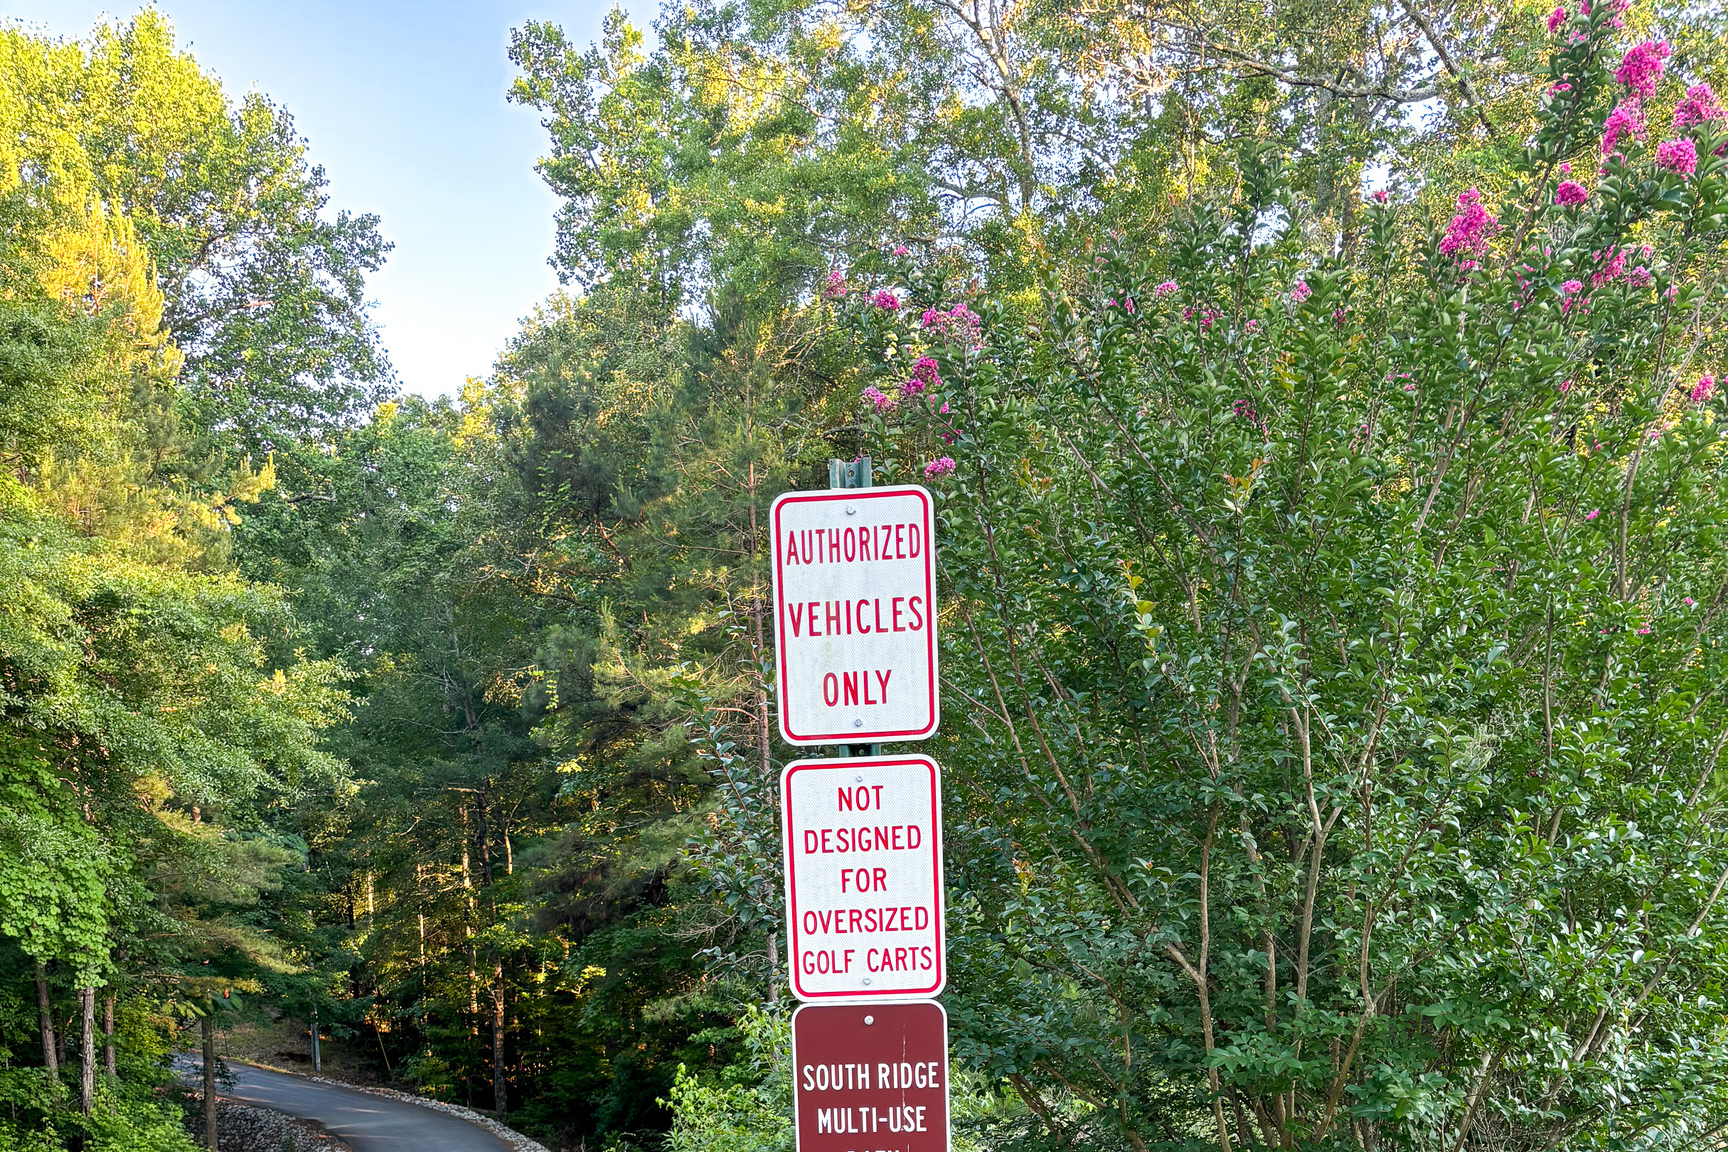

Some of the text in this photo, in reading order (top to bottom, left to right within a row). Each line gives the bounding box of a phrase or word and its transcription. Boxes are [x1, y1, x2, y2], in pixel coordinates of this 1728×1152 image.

[786, 523, 921, 566] AUTHORIZED
[788, 595, 923, 638] VEHICLES
[823, 669, 892, 707] ONLY
[838, 785, 884, 812] NOT
[804, 825, 922, 854] DESIGNED
[841, 867, 887, 893] FOR
[803, 906, 929, 935] OVERSIZED
[802, 946, 933, 975] GOLF CARTS
[803, 1061, 940, 1091] SOUTH RIDGE
[817, 1106, 928, 1134] MULTI-USE
